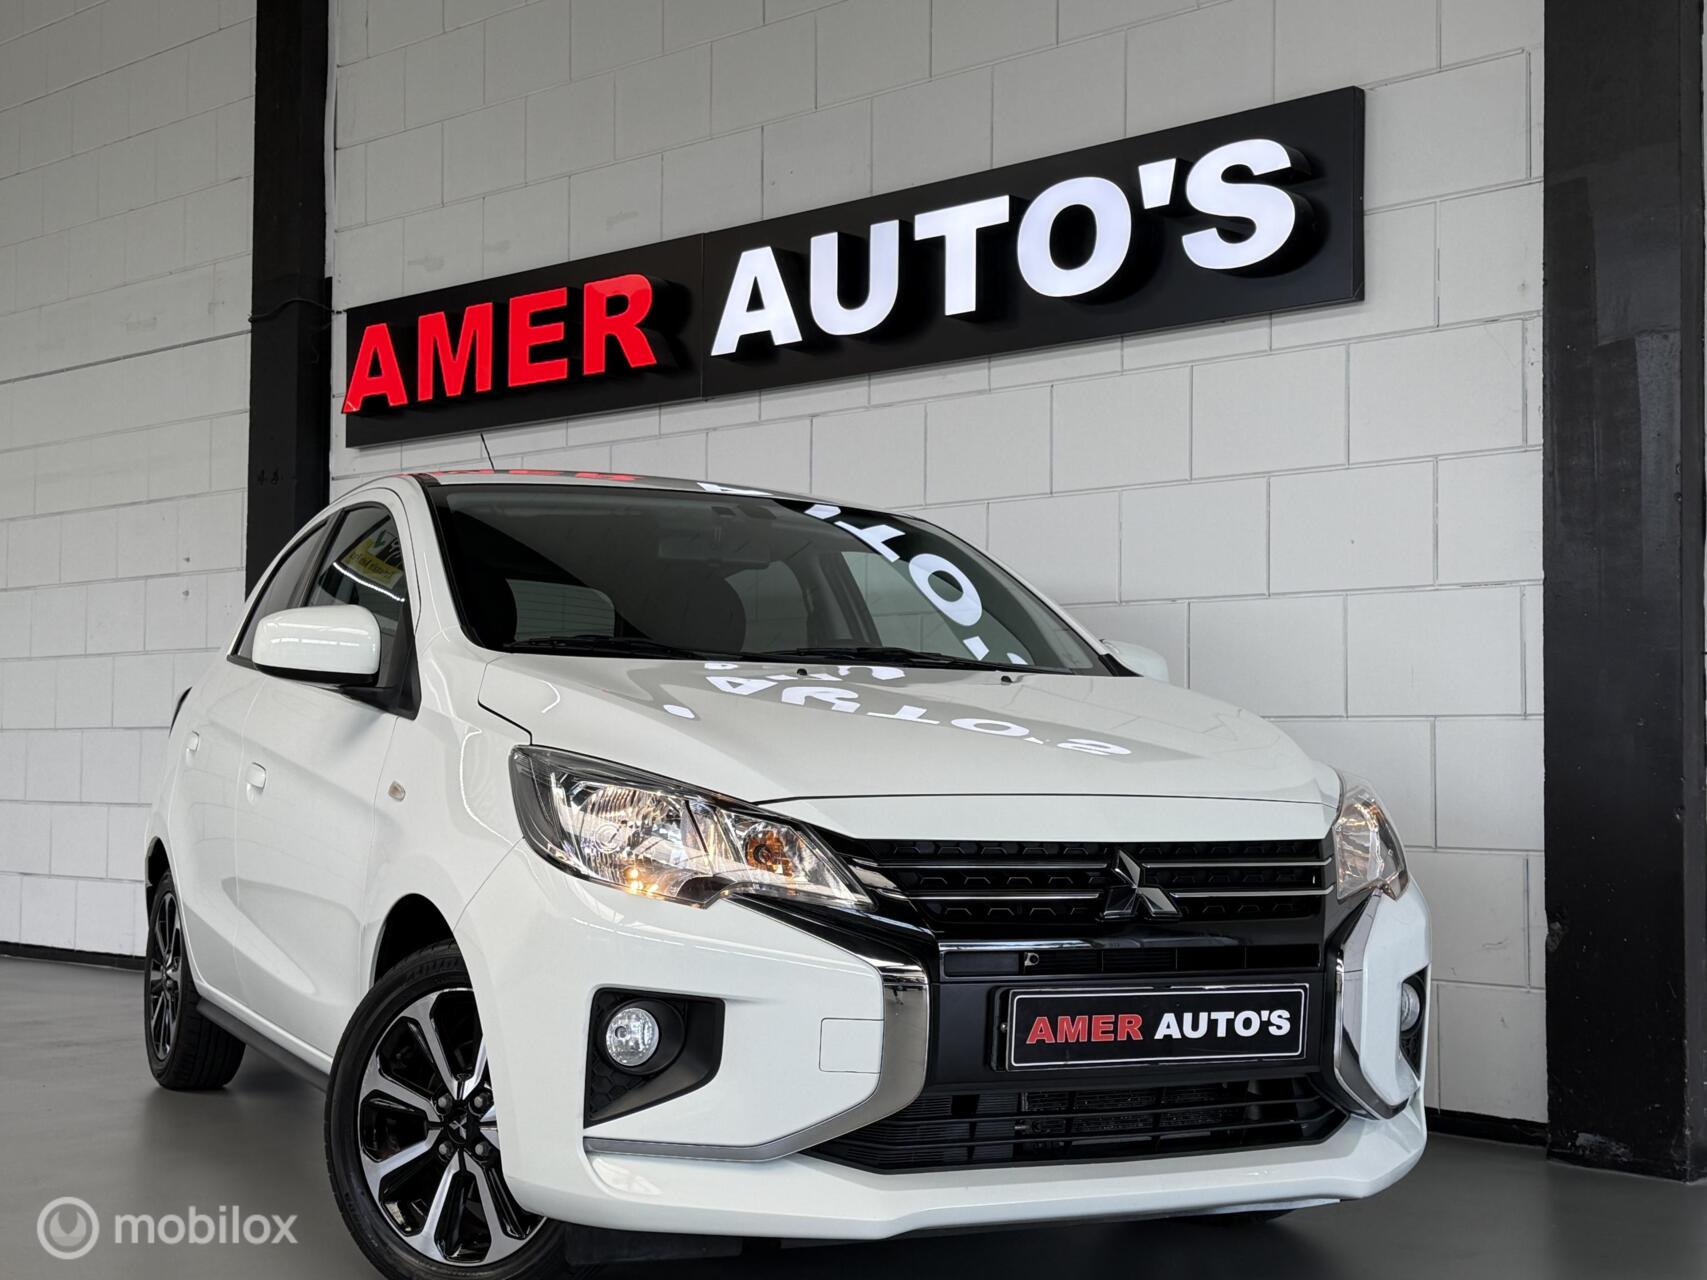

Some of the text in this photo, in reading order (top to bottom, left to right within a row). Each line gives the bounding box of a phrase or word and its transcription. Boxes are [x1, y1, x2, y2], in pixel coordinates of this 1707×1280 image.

[342, 139, 1296, 414] AMER AUTO'S
[1026, 1010, 1291, 1044] AMER AUTO'S
